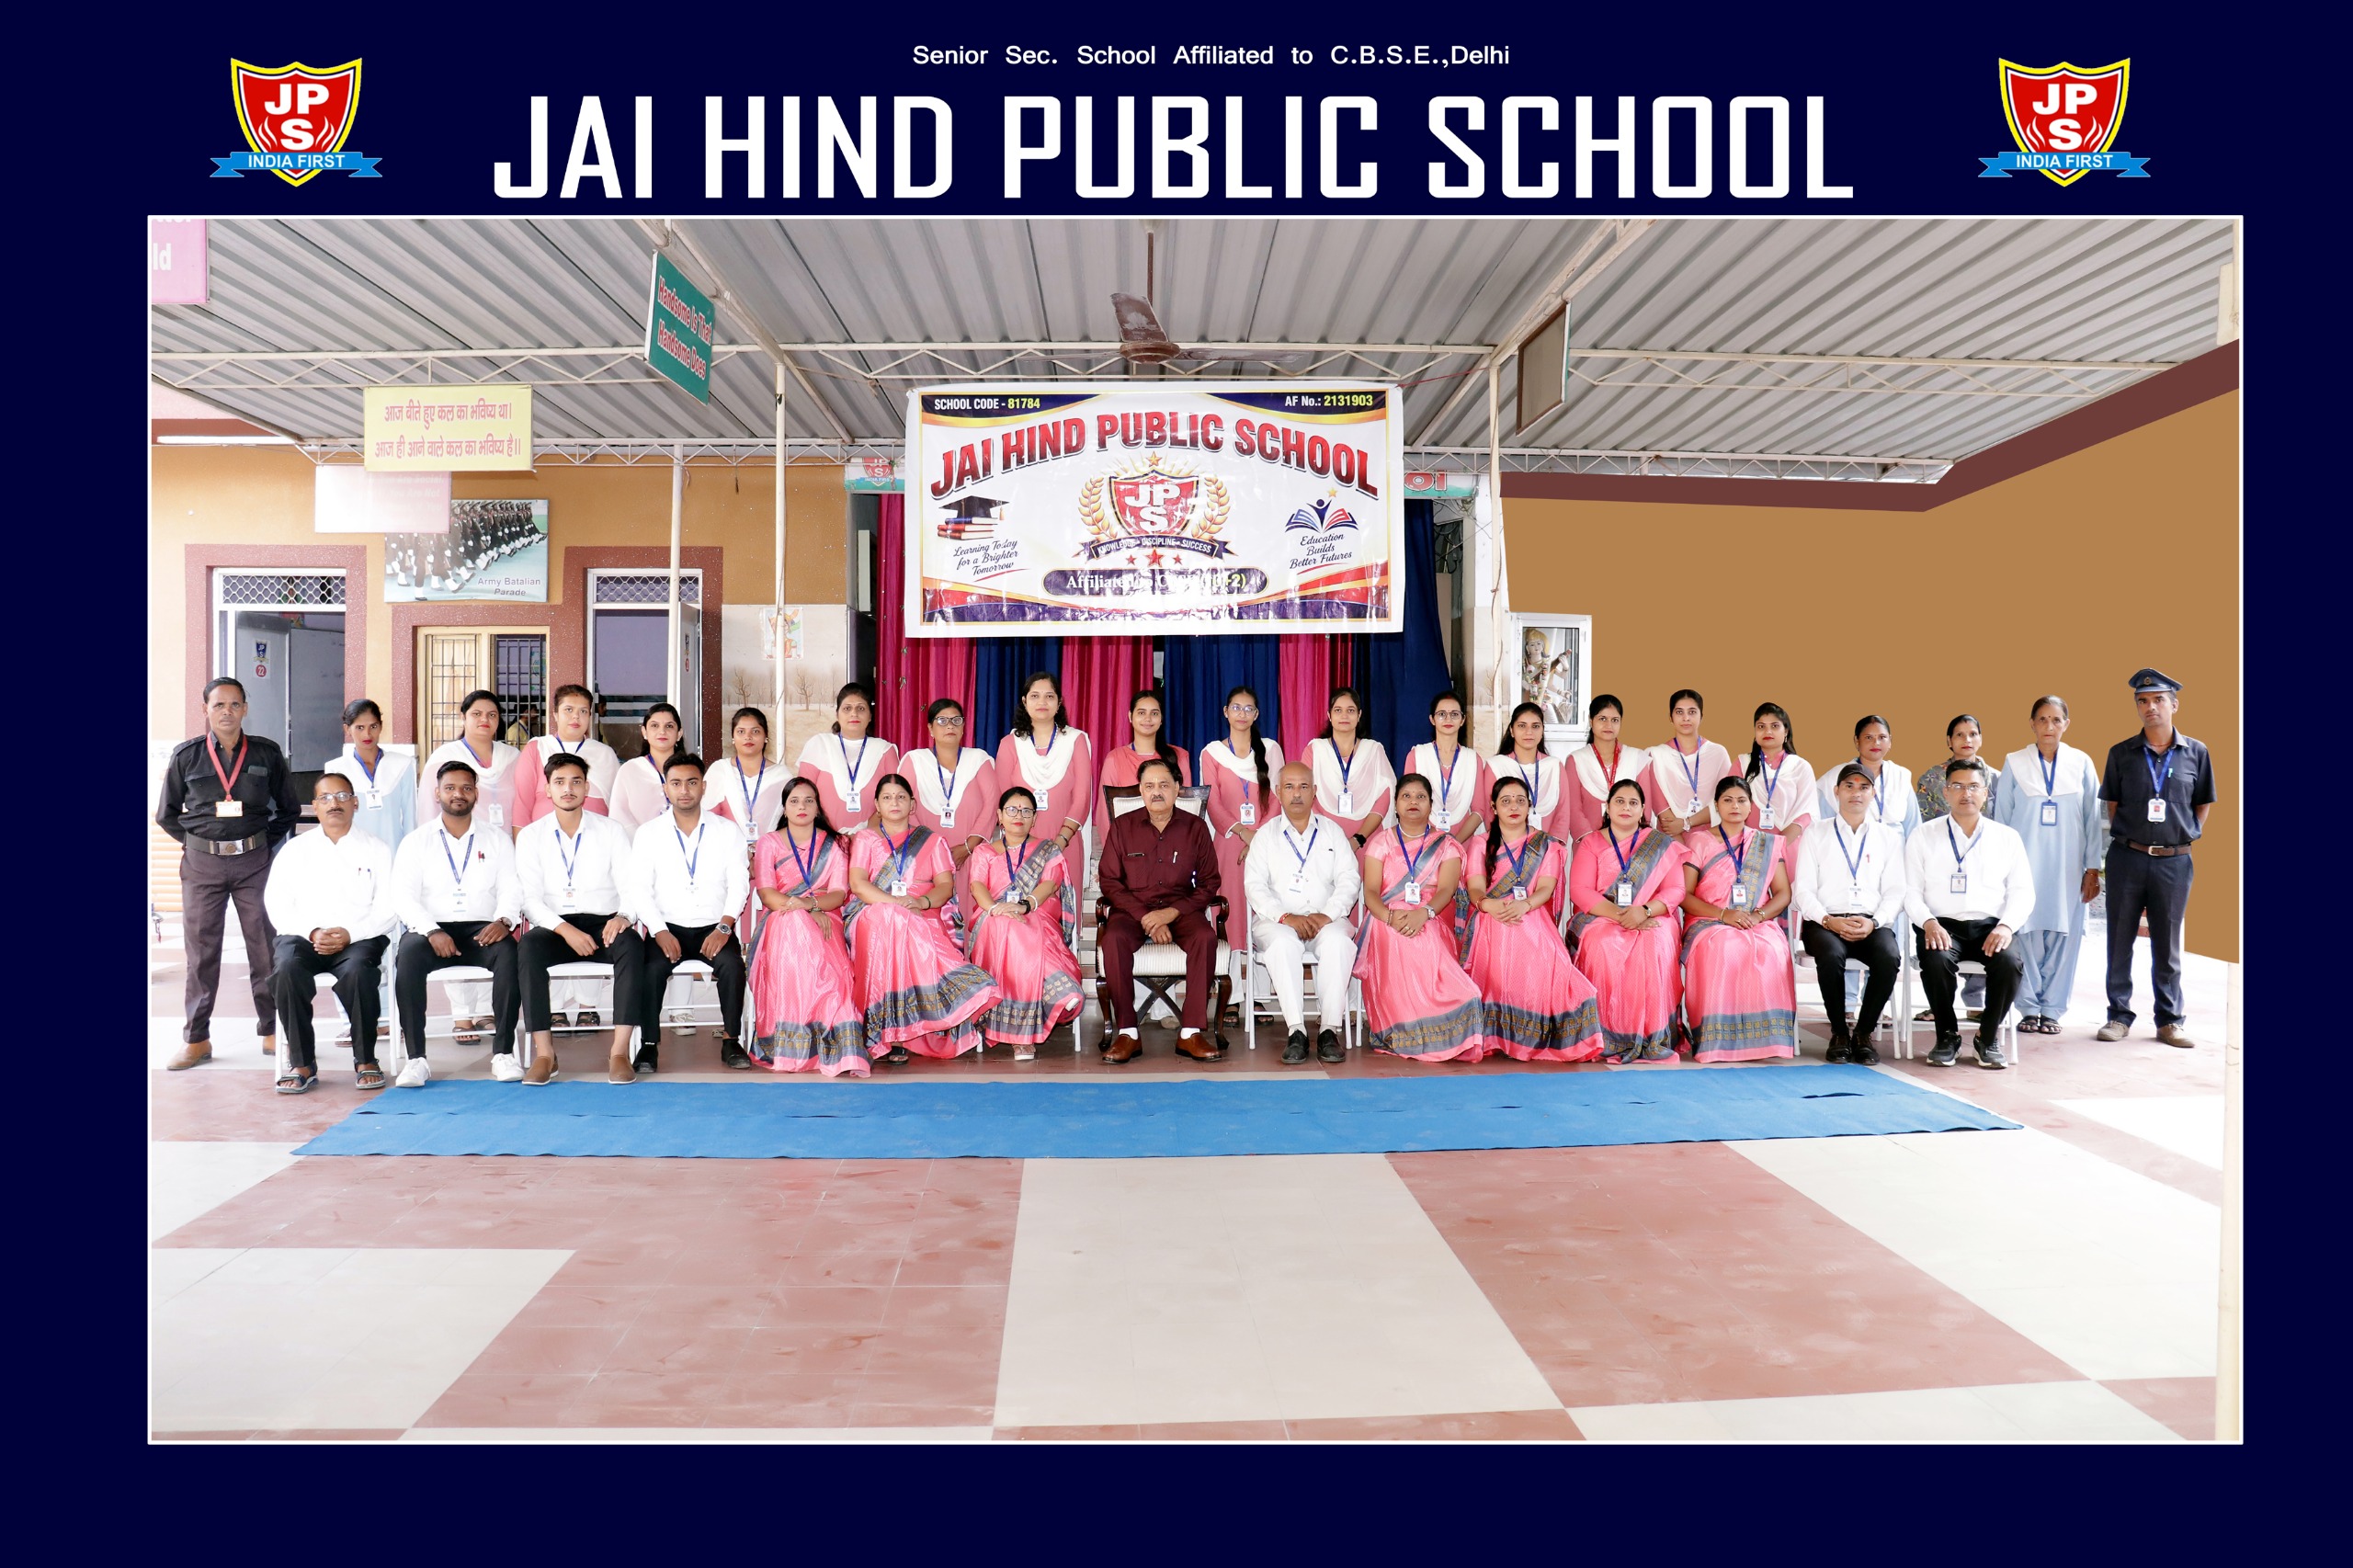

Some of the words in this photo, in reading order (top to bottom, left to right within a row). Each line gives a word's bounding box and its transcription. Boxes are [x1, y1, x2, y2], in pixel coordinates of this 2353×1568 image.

[657, 276, 690, 328] Handsome
[698, 312, 712, 347] That
[657, 319, 690, 369] Handsome
[690, 346, 707, 381] Does
[934, 399, 972, 410] SCHOOL
[973, 398, 999, 409] CODE
[1007, 398, 1040, 409] 81784
[1285, 395, 1299, 406] AF
[1301, 395, 1322, 406] No.:
[1324, 395, 1373, 406] 2131903
[384, 405, 404, 422] आज
[423, 405, 435, 430] हुए
[438, 404, 455, 421] कल
[457, 404, 468, 421] का
[470, 397, 496, 420] भविष्य
[374, 441, 394, 458] आज
[396, 435, 405, 459] ही
[407, 436, 426, 457] आने
[427, 436, 444, 458] वाले
[446, 440, 462, 457] कल
[464, 440, 476, 457] का
[478, 433, 505, 456] भविष्य
[930, 437, 994, 500] JAI
[1001, 417, 1087, 473] HIND
[1097, 411, 1224, 452] PUBLIC
[1233, 418, 1379, 501] SCHOOL
[1124, 483, 1181, 506] JP
[1139, 506, 1169, 535] S
[953, 544, 990, 557] Learning
[993, 539, 1017, 551] Today
[1181, 540, 1211, 553] SUCCESS
[1300, 533, 1345, 547] Education
[1306, 543, 1336, 557] Builds
[956, 557, 971, 571] for
[981, 550, 1018, 564] Brighter
[972, 562, 1014, 576] Tomorrow
[1289, 558, 1317, 570] Better
[1320, 551, 1353, 563] Futures
[478, 578, 502, 587] Army
[504, 577, 541, 585] Batalian
[494, 587, 527, 597] Parade
[257, 666, 265, 676] 22
